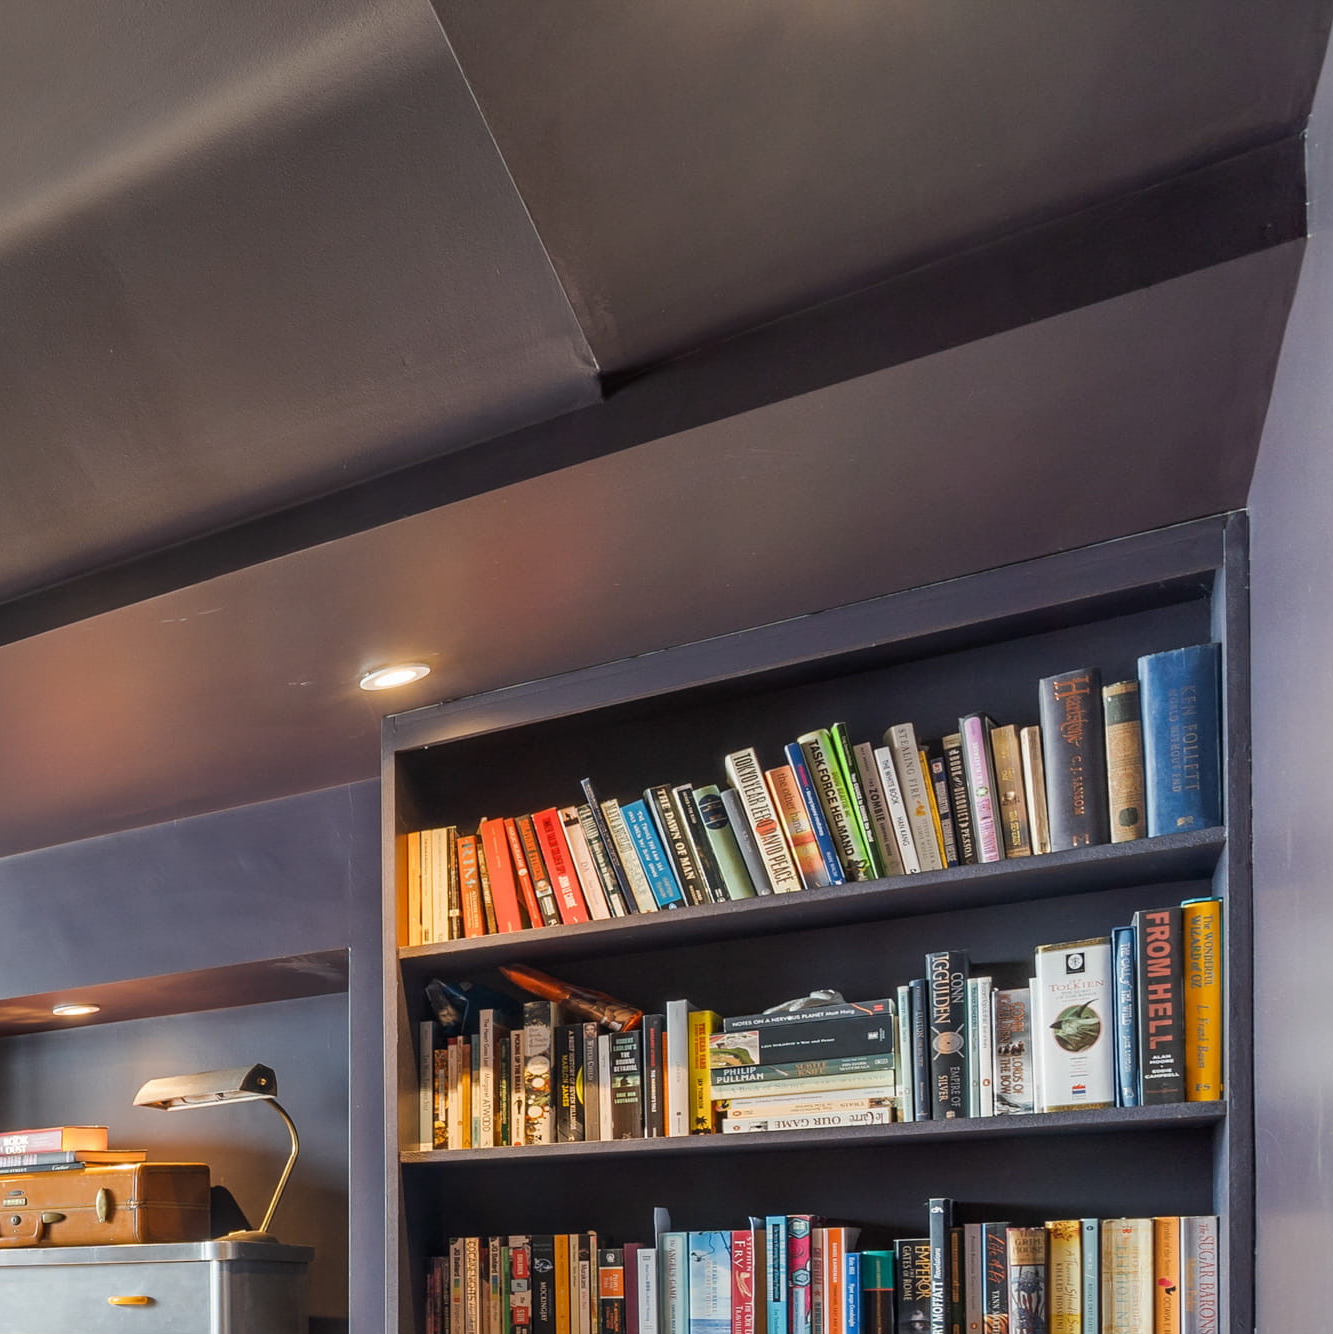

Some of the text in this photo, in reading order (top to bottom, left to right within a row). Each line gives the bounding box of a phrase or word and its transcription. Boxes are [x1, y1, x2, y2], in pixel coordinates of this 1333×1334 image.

[1181, 686, 1200, 791] KEN FOLLETT
[898, 728, 919, 799] STEALING FIRE
[808, 739, 854, 856] TASK FORCE HELMAND
[869, 788, 885, 822] ZOMBIE
[656, 789, 696, 880] THE DAWN OF MAN
[1203, 915, 1214, 986] The WONDERFUL
[932, 952, 950, 1024] IGGULDEN
[951, 972, 964, 1004] CONN
[1050, 979, 1104, 992] TOLKIEN
[1146, 912, 1173, 1049] FROM HELL
[716, 1073, 764, 1084] PULLMAN
[723, 1067, 756, 1076] PHILIP
[938, 1075, 948, 1102] SILVER
[950, 1067, 960, 1107] EMPIRE OF
[3, 1135, 28, 1146] BOOK
[775, 1116, 841, 1129] OUR GAME
[6, 1146, 26, 1154] DUST
[915, 1245, 931, 1300] EMPEROR
[933, 1248, 941, 1279] Revelations
[1199, 1224, 1217, 1334] The SUGAR BARONS
[932, 1281, 943, 1322] MOFFATT
